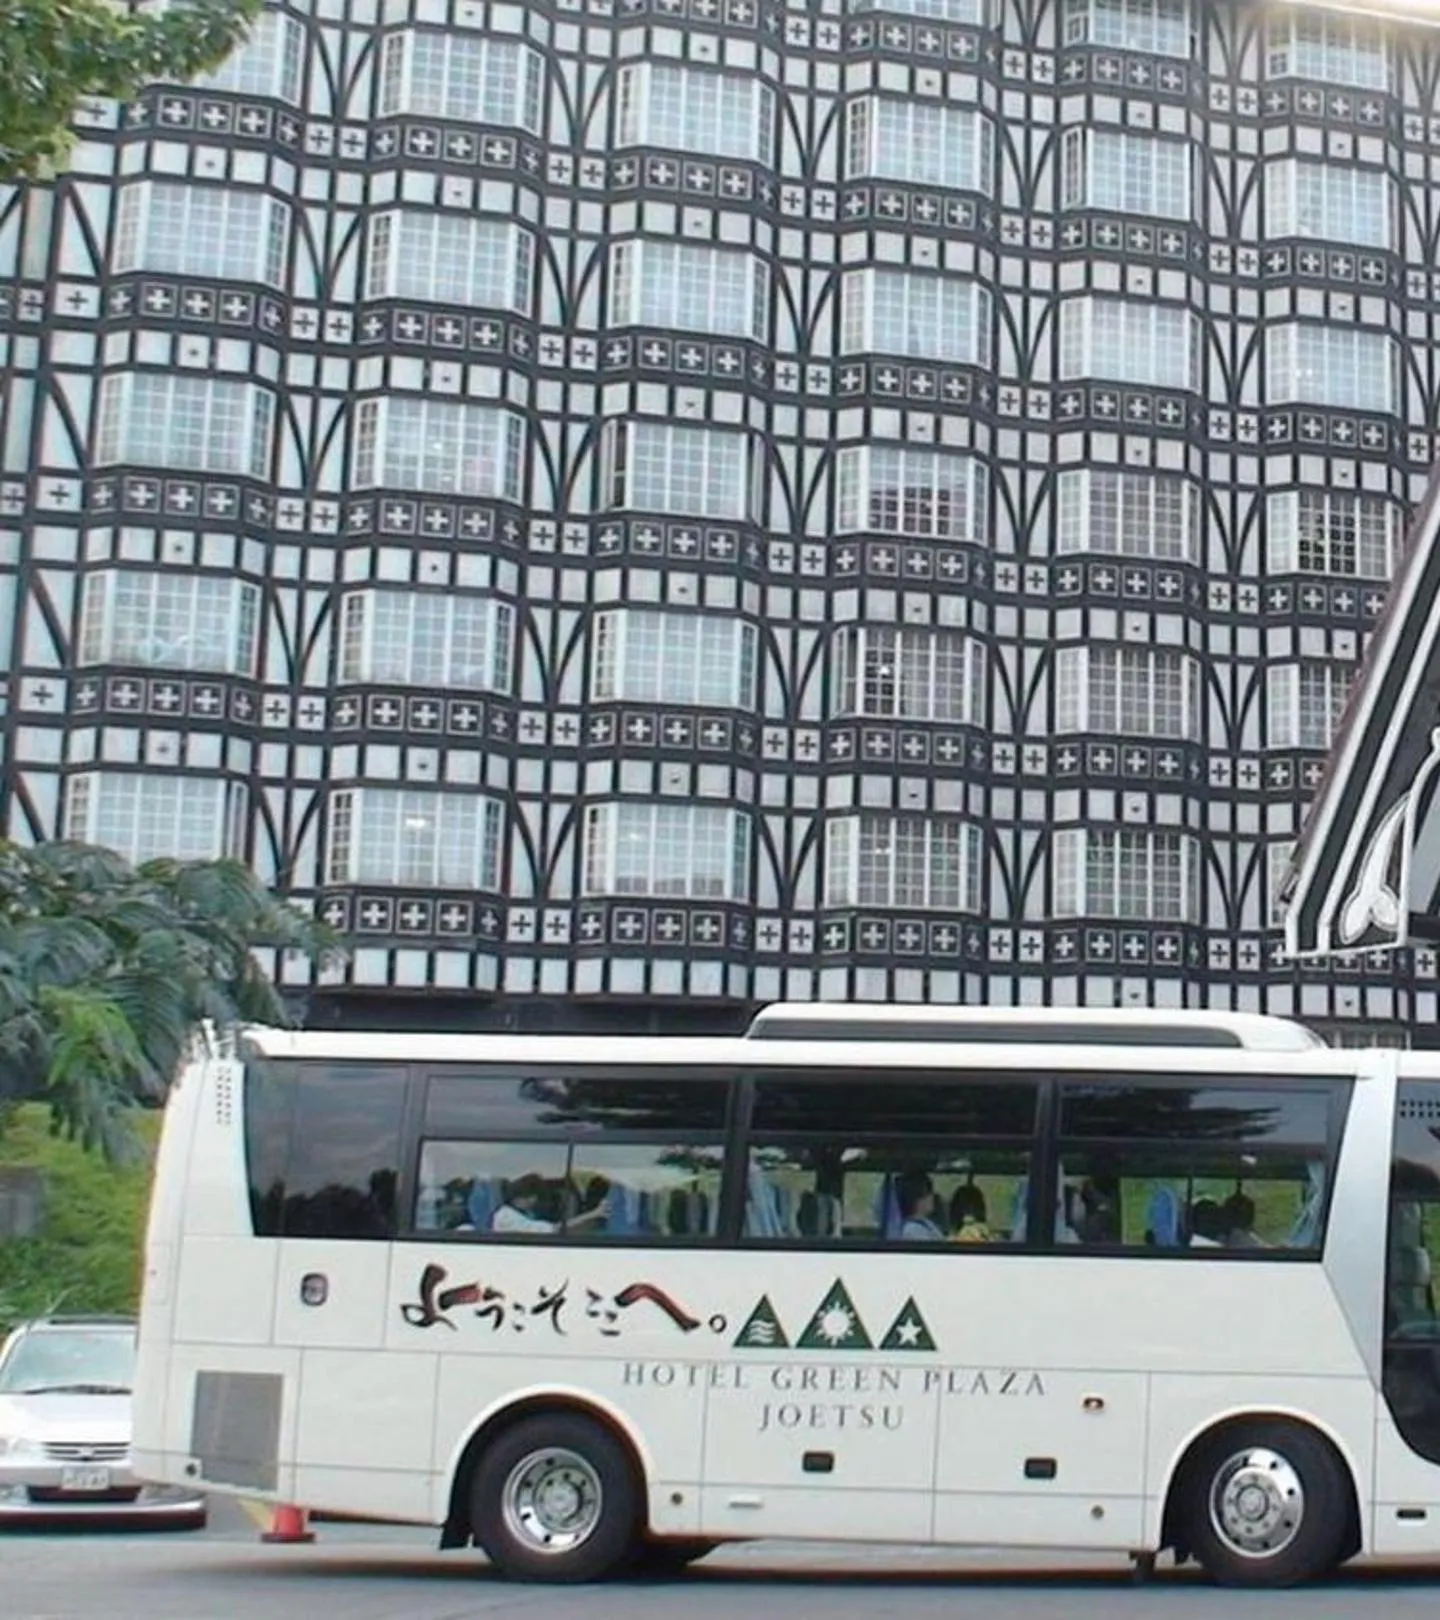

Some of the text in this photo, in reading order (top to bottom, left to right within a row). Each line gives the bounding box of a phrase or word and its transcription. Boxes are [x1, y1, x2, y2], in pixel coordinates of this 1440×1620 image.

[623, 1363, 1046, 1396] HOTEL GREEN PLAZA
[759, 1403, 904, 1431] JOETSU
